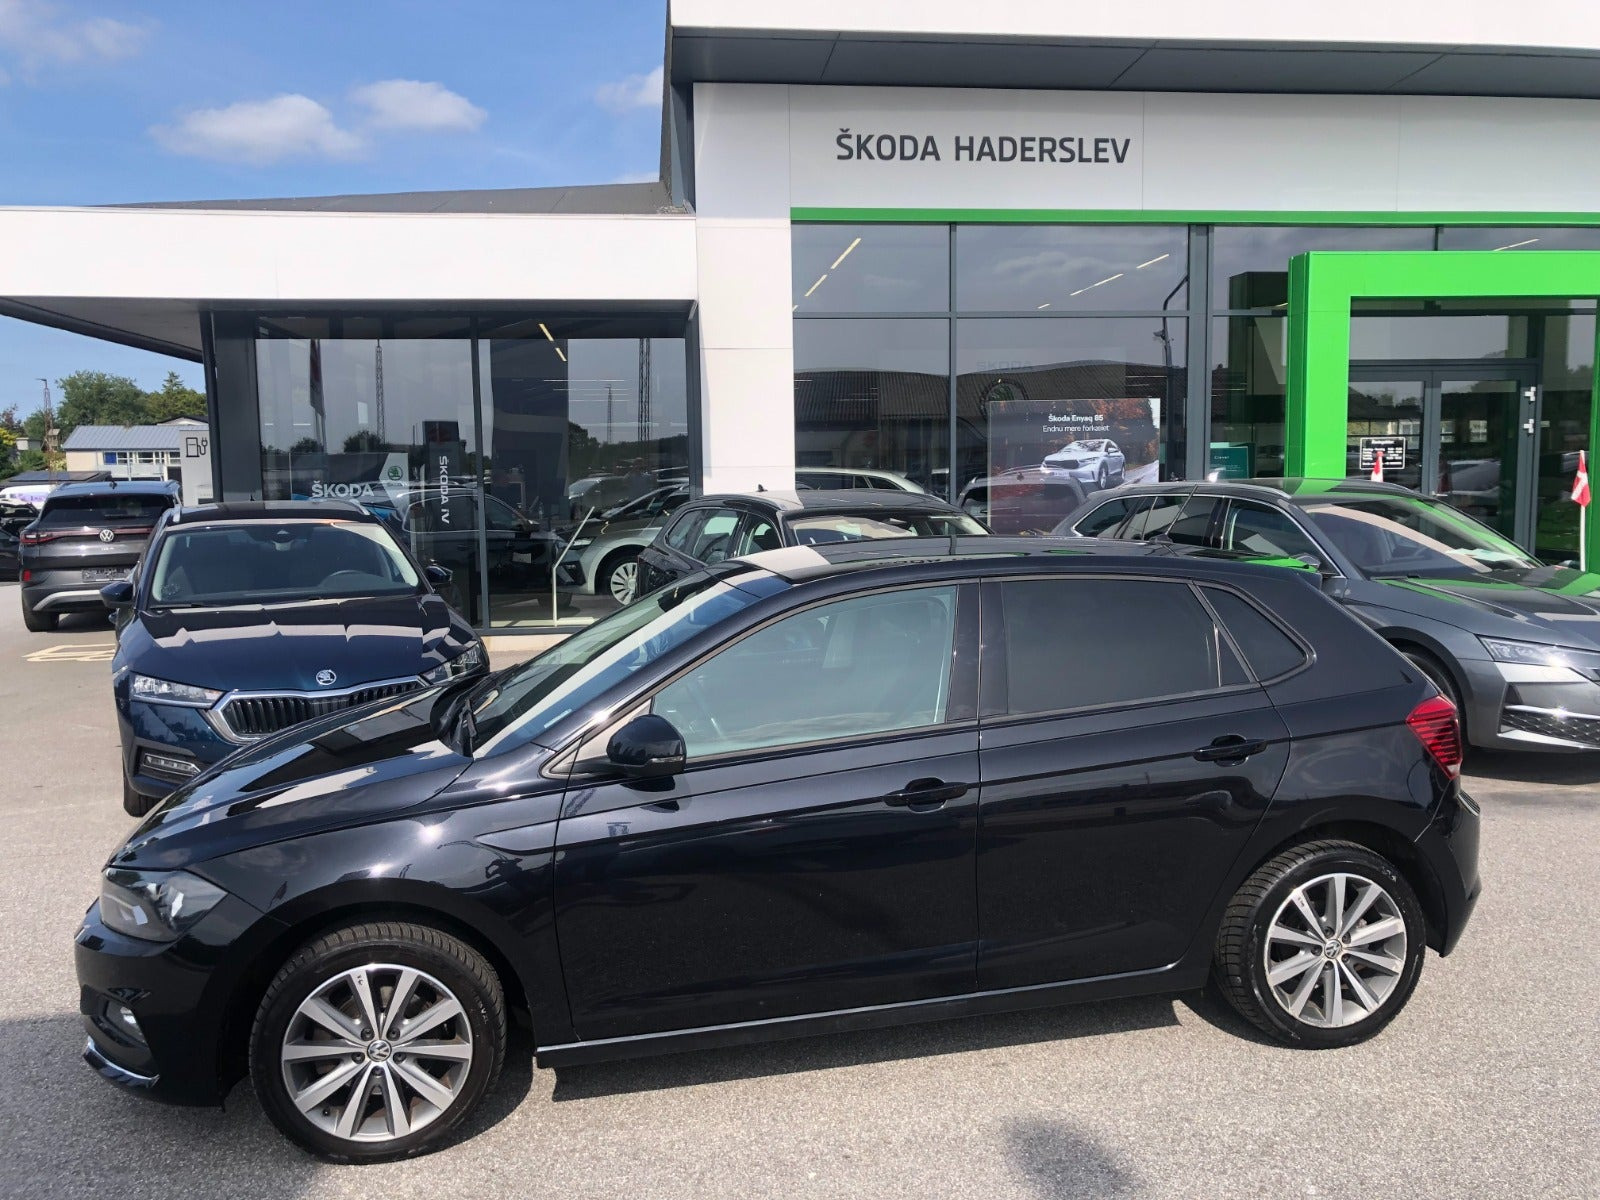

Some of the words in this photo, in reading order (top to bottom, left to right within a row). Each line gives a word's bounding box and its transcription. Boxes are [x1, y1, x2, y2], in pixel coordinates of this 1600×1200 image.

[836, 128, 940, 161] ŠKODA
[955, 136, 1131, 164] HADERSLEV
[1048, 413, 1070, 422] Škoda
[1071, 414, 1093, 424] Enyaq
[311, 480, 375, 498] ŠKODA
[439, 455, 450, 505] ŠKODA
